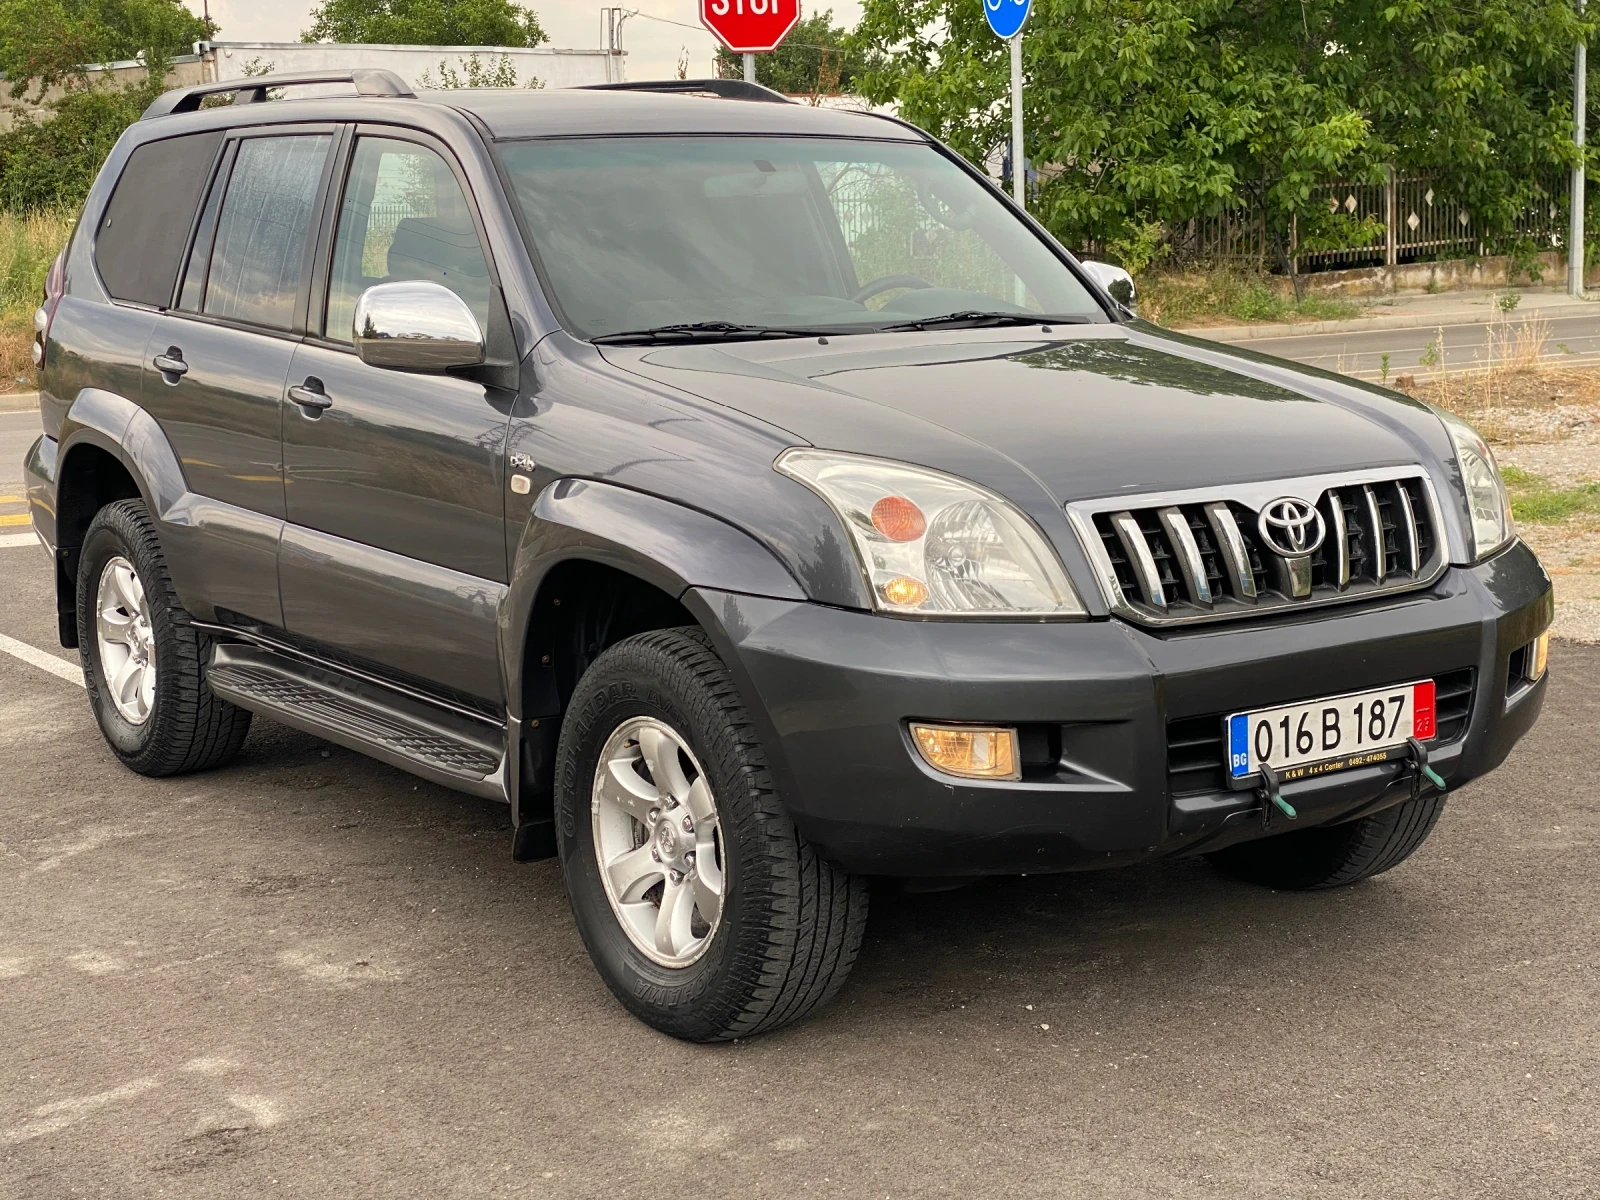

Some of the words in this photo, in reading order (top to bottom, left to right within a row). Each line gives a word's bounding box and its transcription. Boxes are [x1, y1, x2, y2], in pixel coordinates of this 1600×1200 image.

[562, 681, 639, 838] GEOLANDAR
[1233, 752, 1247, 768] BG
[1324, 761, 1344, 771] Center
